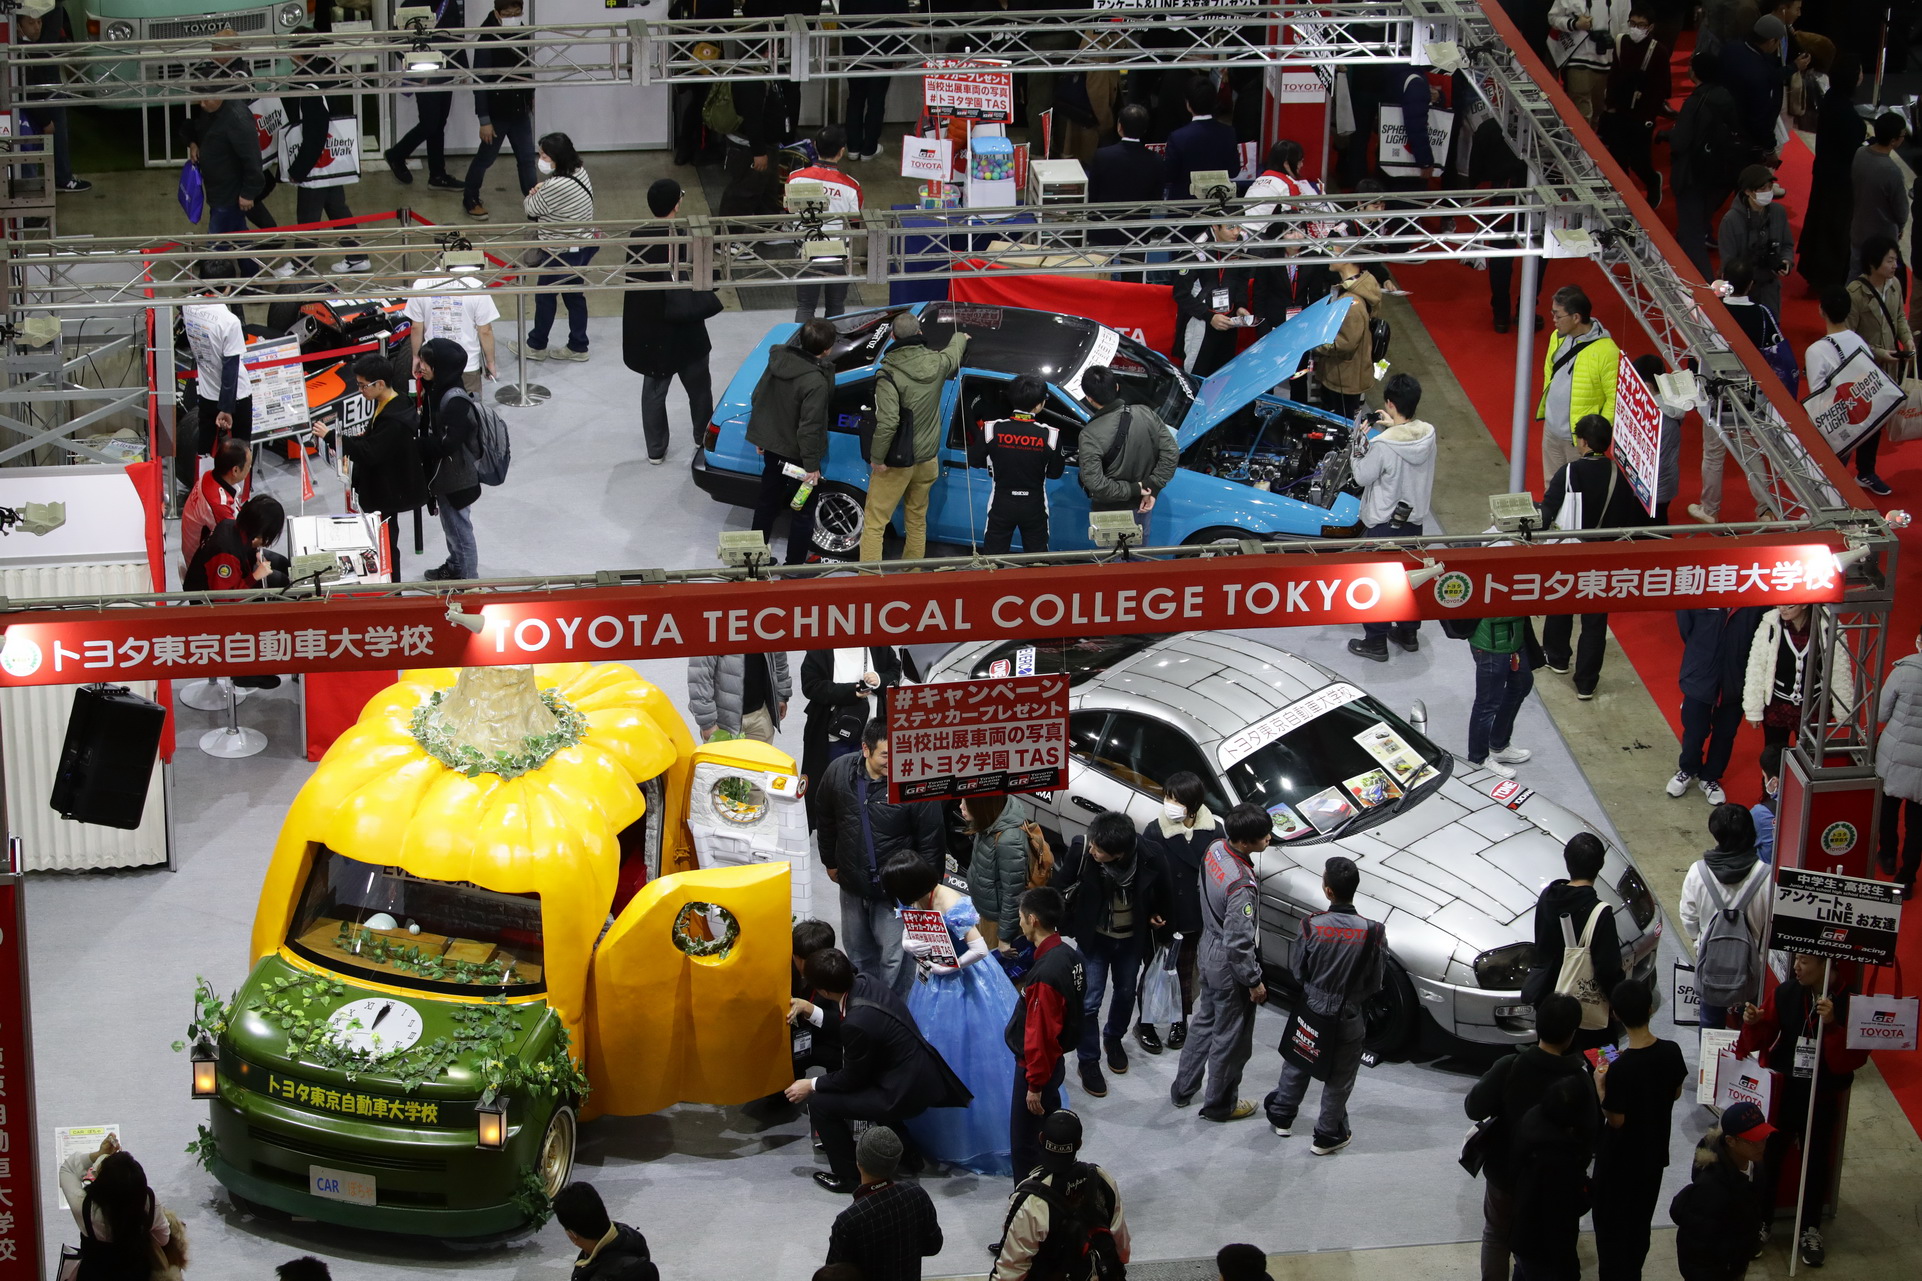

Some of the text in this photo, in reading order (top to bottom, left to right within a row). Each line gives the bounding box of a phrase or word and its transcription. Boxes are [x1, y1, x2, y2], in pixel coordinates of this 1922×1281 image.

[184, 21, 232, 33] TOYOTA
[927, 80, 1008, 98] 当校出展車両の写真
[1284, 83, 1325, 91] TOYOTA
[985, 98, 1007, 110] TAS
[258, 110, 282, 129] Liberty
[265, 119, 283, 136] Walk
[326, 138, 354, 150] Liberty
[911, 160, 942, 169] TOYOTA
[1619, 358, 1659, 426] #キャンペーン
[1851, 369, 1880, 397] Liberty
[1862, 381, 1885, 402] Walk
[1815, 399, 1847, 428] SPHERE
[1825, 412, 1850, 435] LIGHT
[997, 433, 1045, 448] TOYOTA
[1641, 459, 1653, 489] TAS
[1484, 559, 1835, 604] トヨタ東京自動車大学校
[493, 577, 1382, 653] TOYOTA TECHNICAL COLLEGE TOKYO
[54, 624, 435, 673] トヨタ東京自動車大学校
[894, 679, 1063, 710] #キャンペーン
[893, 701, 1063, 728] ステッカープレゼント
[1224, 686, 1356, 760] トヨタ東京自動車大学校
[896, 722, 1063, 754] 当校出展車両の写真
[900, 747, 1060, 777] #トヨタ学園 TAS
[1492, 781, 1518, 799] TONE
[1797, 874, 1885, 897] 中学生・高校生
[1779, 888, 1843, 909] アンケート
[1859, 893, 1880, 901] students
[1817, 907, 1897, 931] LINE お友達
[1776, 932, 1815, 944] TOYOTA
[1817, 940, 1852, 950] GAZOO
[1821, 927, 1848, 942] GR
[1783, 945, 1880, 965] オリジナルバッグプレゼント
[1297, 1015, 1319, 1038] CHANGE
[1871, 1011, 1896, 1023] GR
[1295, 1029, 1316, 1048] HAPPY
[1860, 1028, 1904, 1037] TOYOTA
[1738, 1075, 1759, 1090] GR
[269, 1074, 439, 1124] トヨタ東京自動車大学校
[1728, 1089, 1762, 1109] TOYOTA
[316, 1176, 340, 1193] CAR
[871, 1182, 888, 1191] Canon
